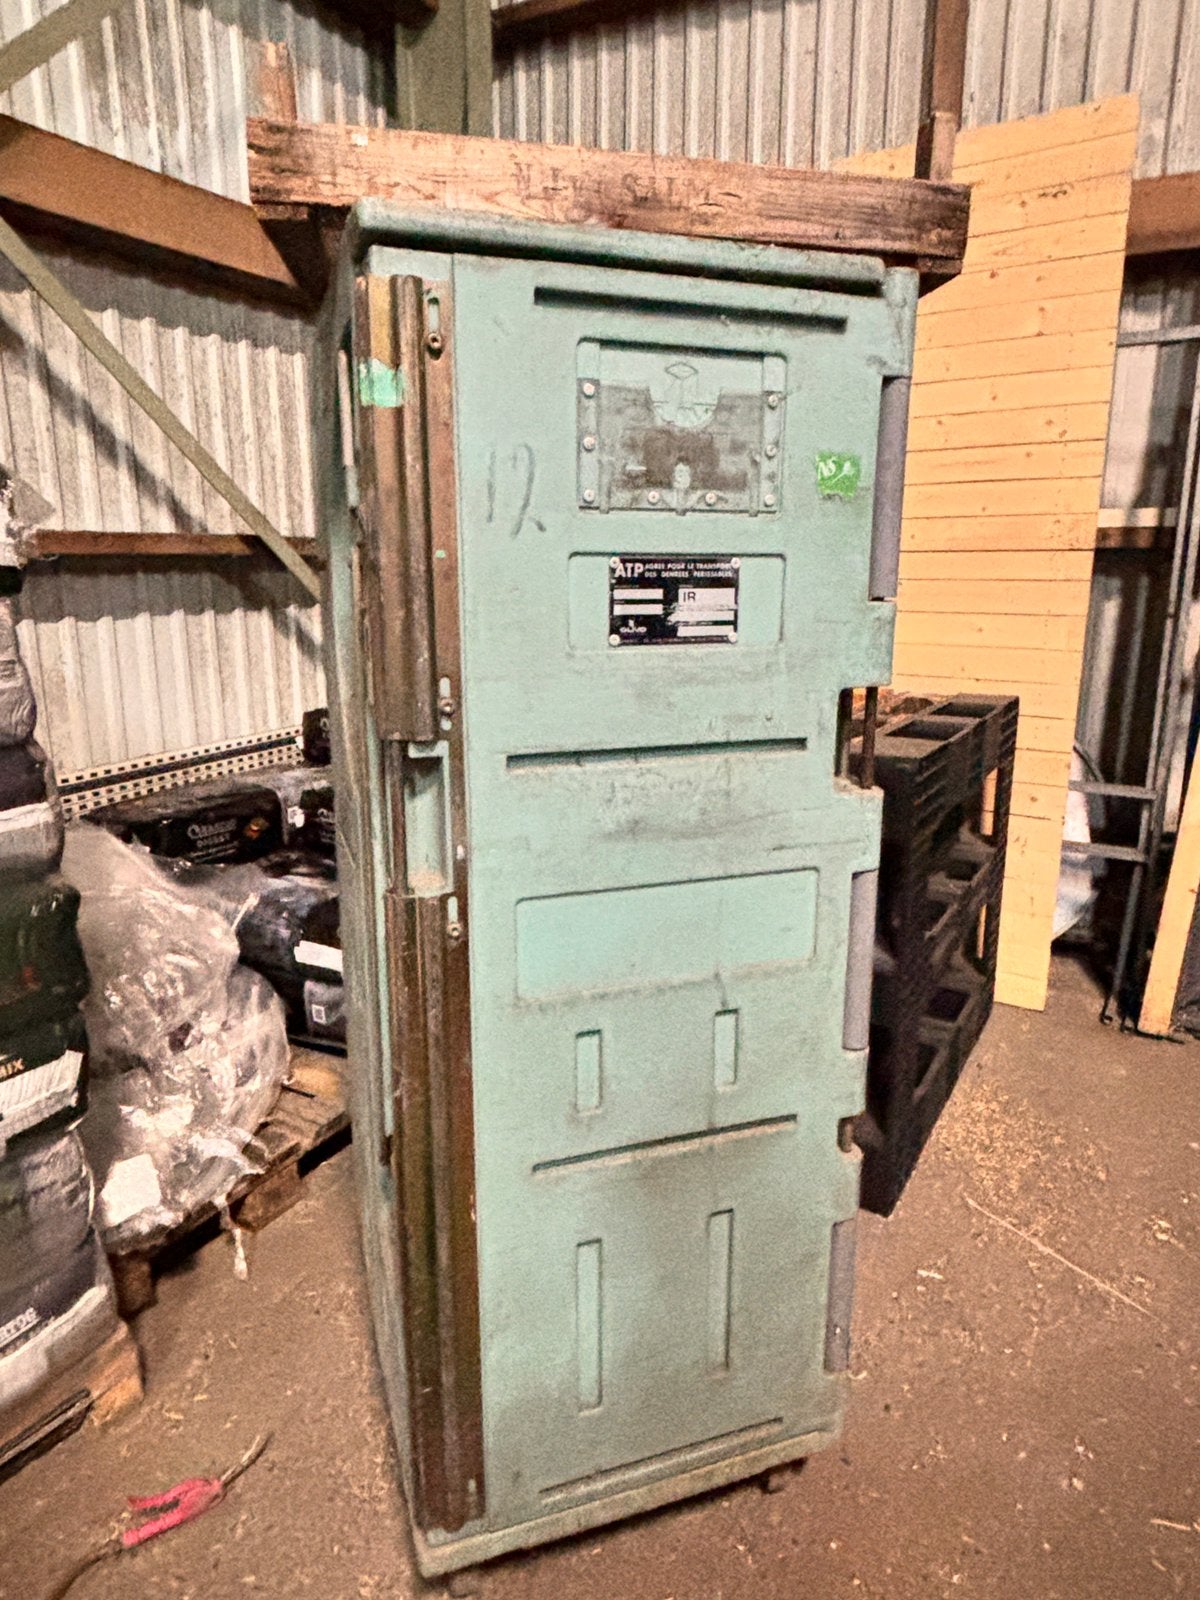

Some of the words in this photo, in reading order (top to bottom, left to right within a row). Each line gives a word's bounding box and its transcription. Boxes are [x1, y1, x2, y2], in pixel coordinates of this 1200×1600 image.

[614, 562, 644, 578] ATP
[667, 562, 686, 570] POUR
[687, 562, 695, 570] LE
[644, 570, 657, 578] DES
[683, 591, 696, 602] IR
